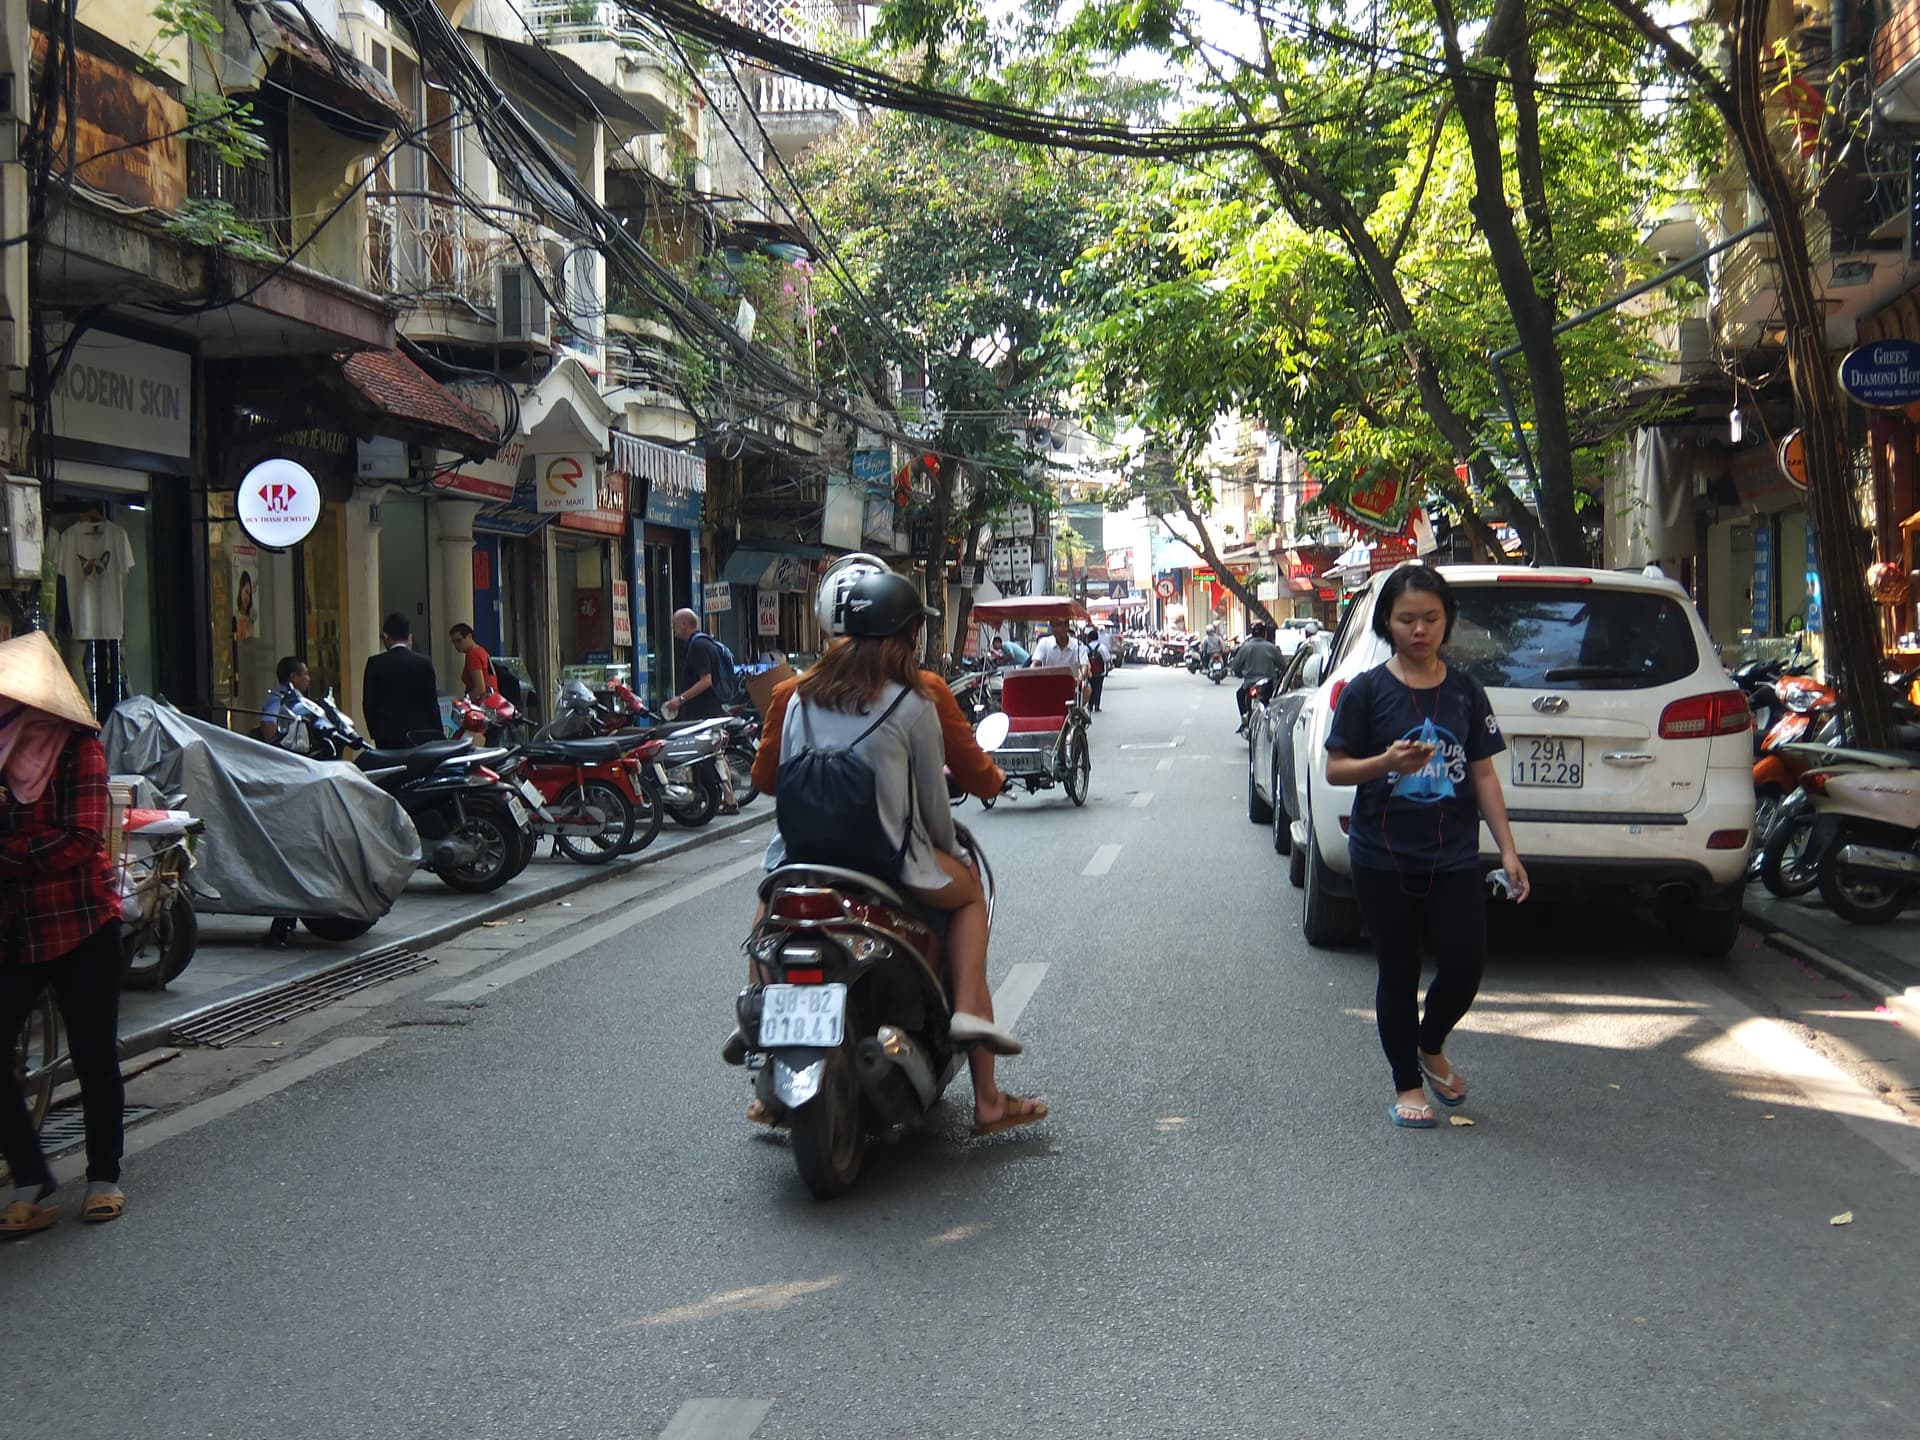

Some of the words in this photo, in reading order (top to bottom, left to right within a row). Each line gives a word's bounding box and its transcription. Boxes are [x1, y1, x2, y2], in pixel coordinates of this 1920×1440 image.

[141, 378, 180, 421] SKIN
[1530, 739, 1566, 762] 29A
[1517, 761, 1580, 784] 112.28
